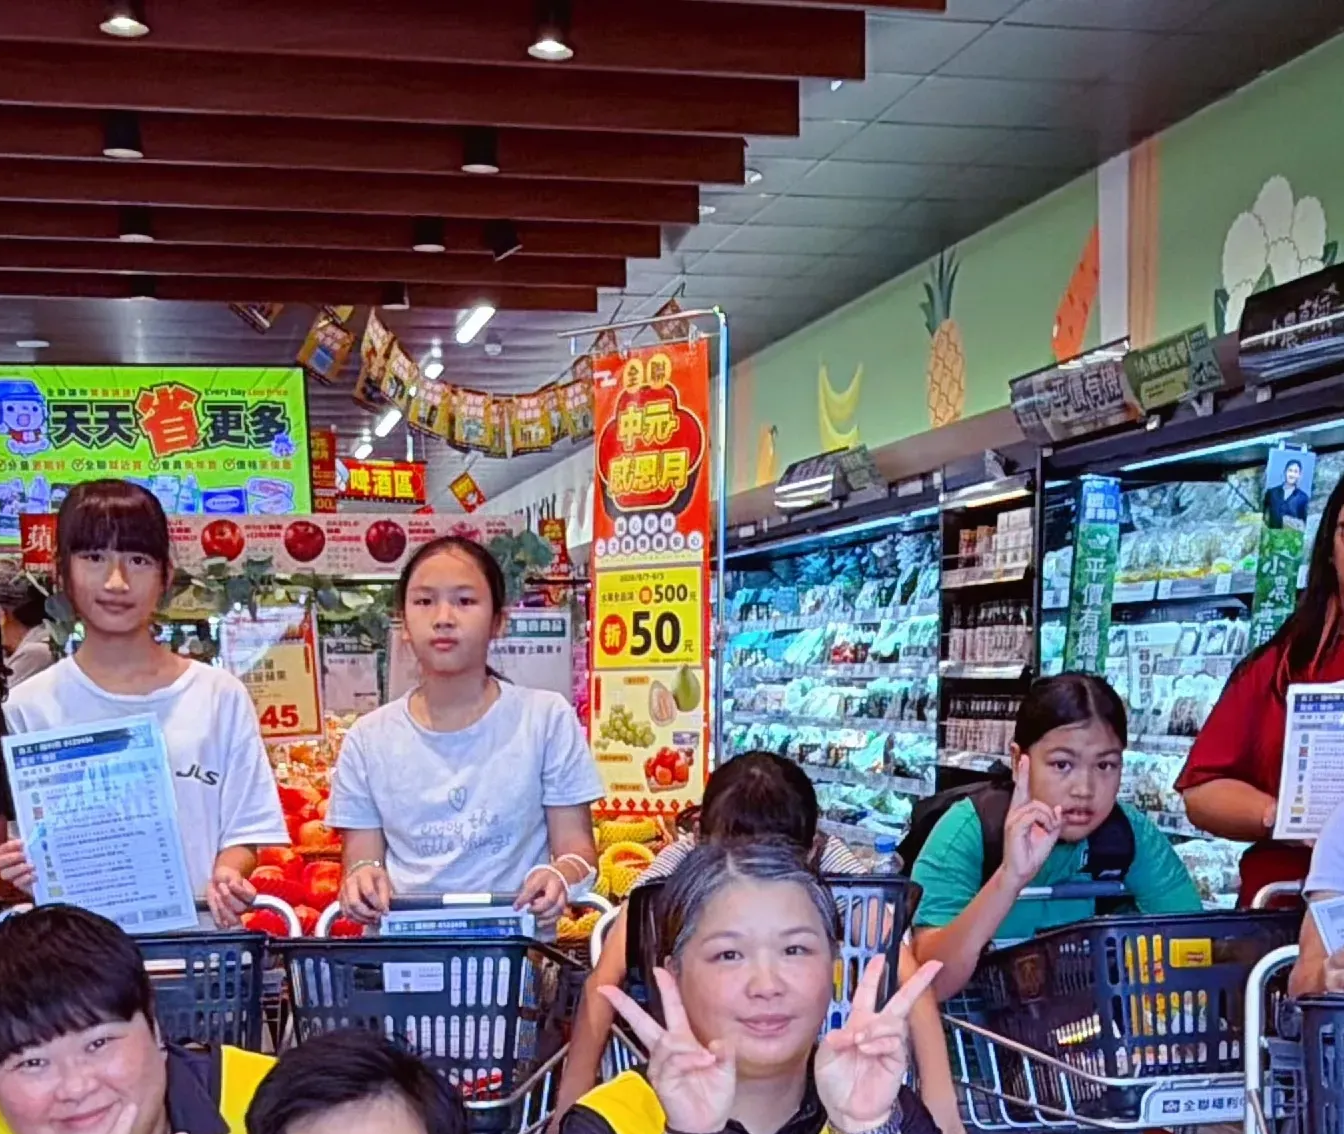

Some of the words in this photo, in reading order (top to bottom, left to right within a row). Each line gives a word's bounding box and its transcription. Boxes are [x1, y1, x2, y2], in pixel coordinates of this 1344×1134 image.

[49, 383, 290, 457] 天天省更多
[618, 401, 679, 450] 中元
[350, 468, 415, 498] 啤酒區
[610, 449, 690, 494] 感恩月
[26, 523, 54, 552] 蘋
[260, 704, 299, 729] 45
[175, 763, 220, 787] JLS
